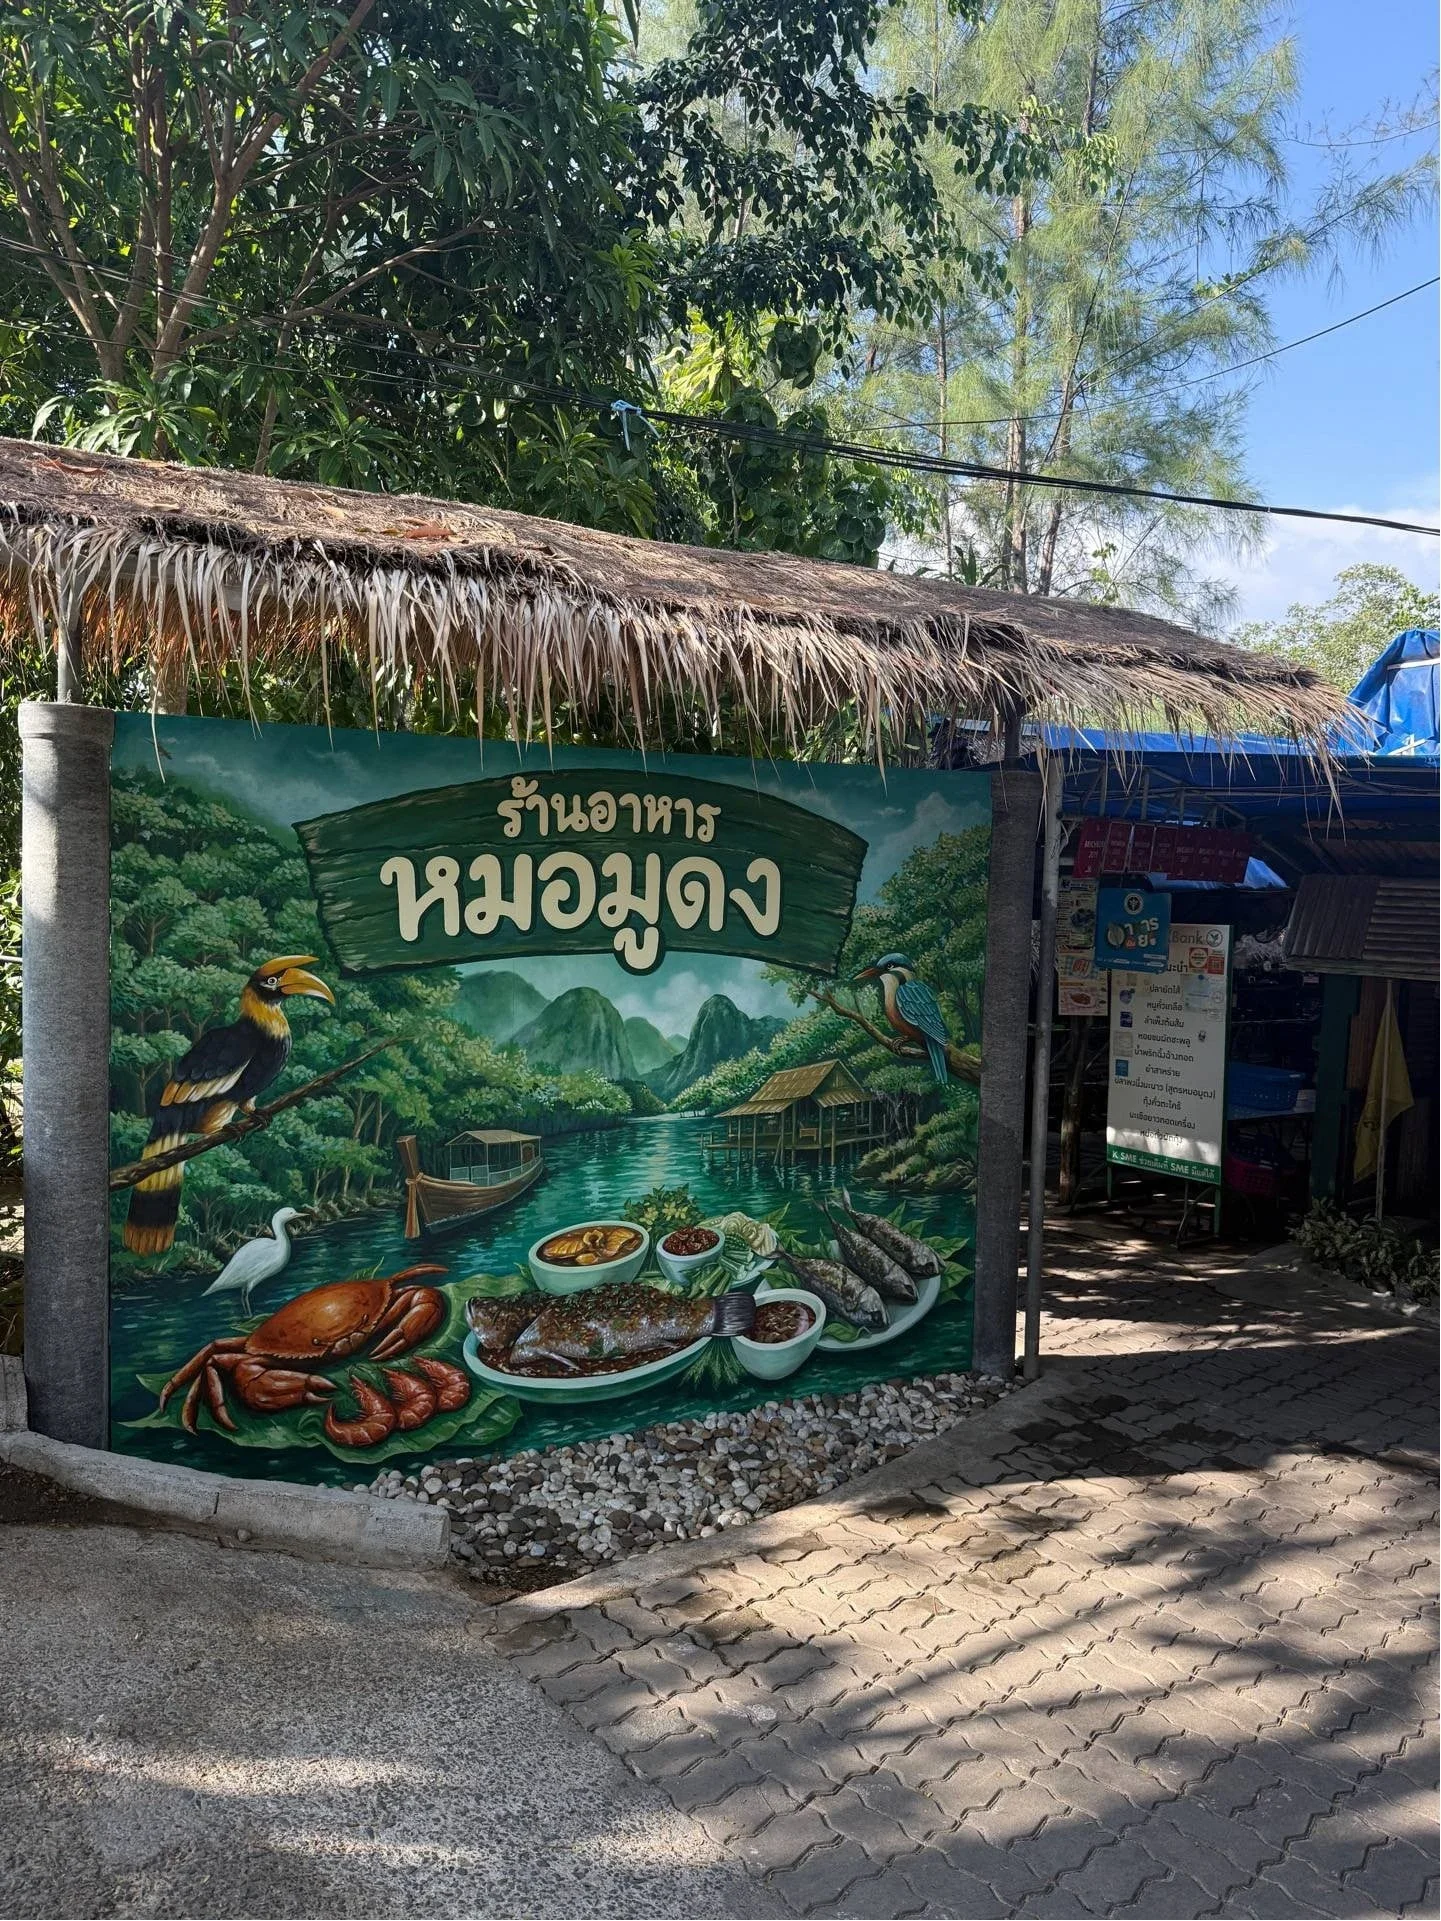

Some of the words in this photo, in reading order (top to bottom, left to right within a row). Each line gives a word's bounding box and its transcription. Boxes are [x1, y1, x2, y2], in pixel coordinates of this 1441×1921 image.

[496, 776, 721, 843] ร้านอาหาร
[380, 851, 782, 970] หมอมูดง
[1168, 930, 1204, 944] Bank
[1145, 1064, 1181, 1077] ยำสาหร่าย
[1112, 1150, 1119, 1159] K
[1120, 1152, 1137, 1163] SME
[1170, 1160, 1189, 1174] SME
